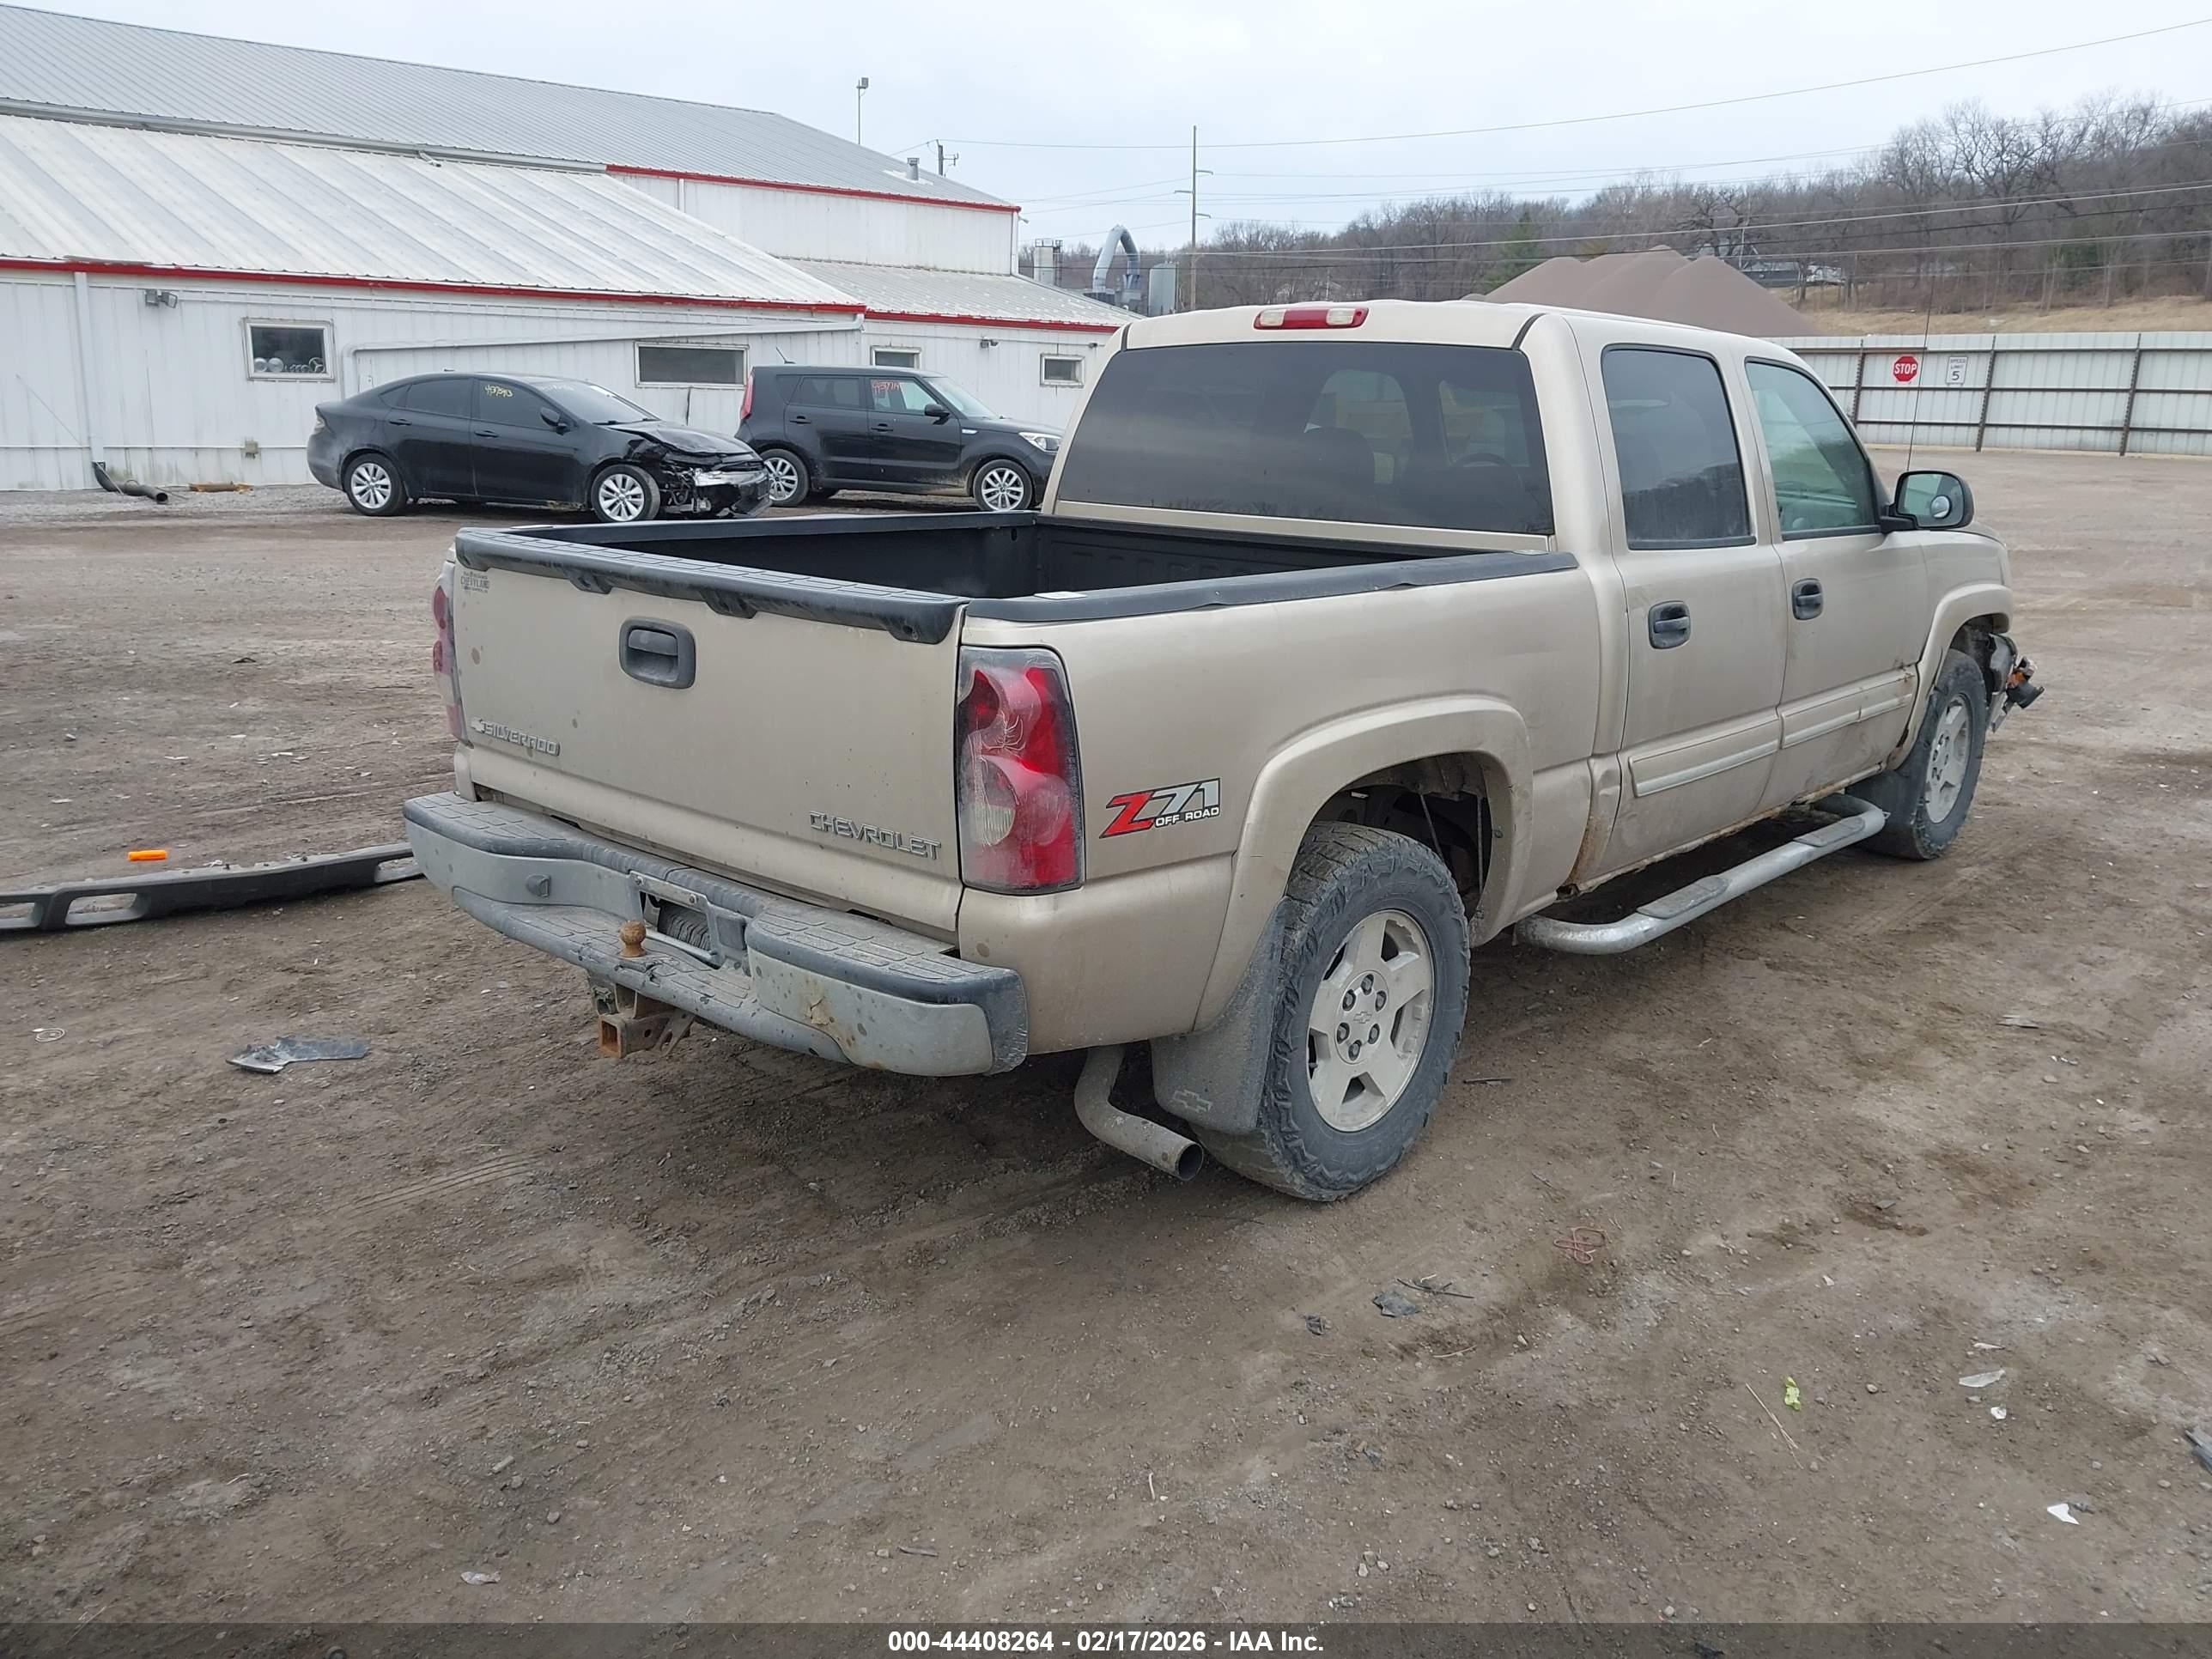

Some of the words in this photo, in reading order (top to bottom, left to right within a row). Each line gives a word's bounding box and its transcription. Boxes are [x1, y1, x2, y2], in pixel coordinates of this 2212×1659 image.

[1894, 363, 1917, 374] STOP
[1952, 371, 1960, 380] 5
[483, 722, 560, 757] SILVERADO
[1099, 777, 1220, 839] Z71
[1155, 814, 1180, 828] OFF
[1185, 806, 1219, 822] ROAD
[810, 811, 941, 860] CHEVROLET
